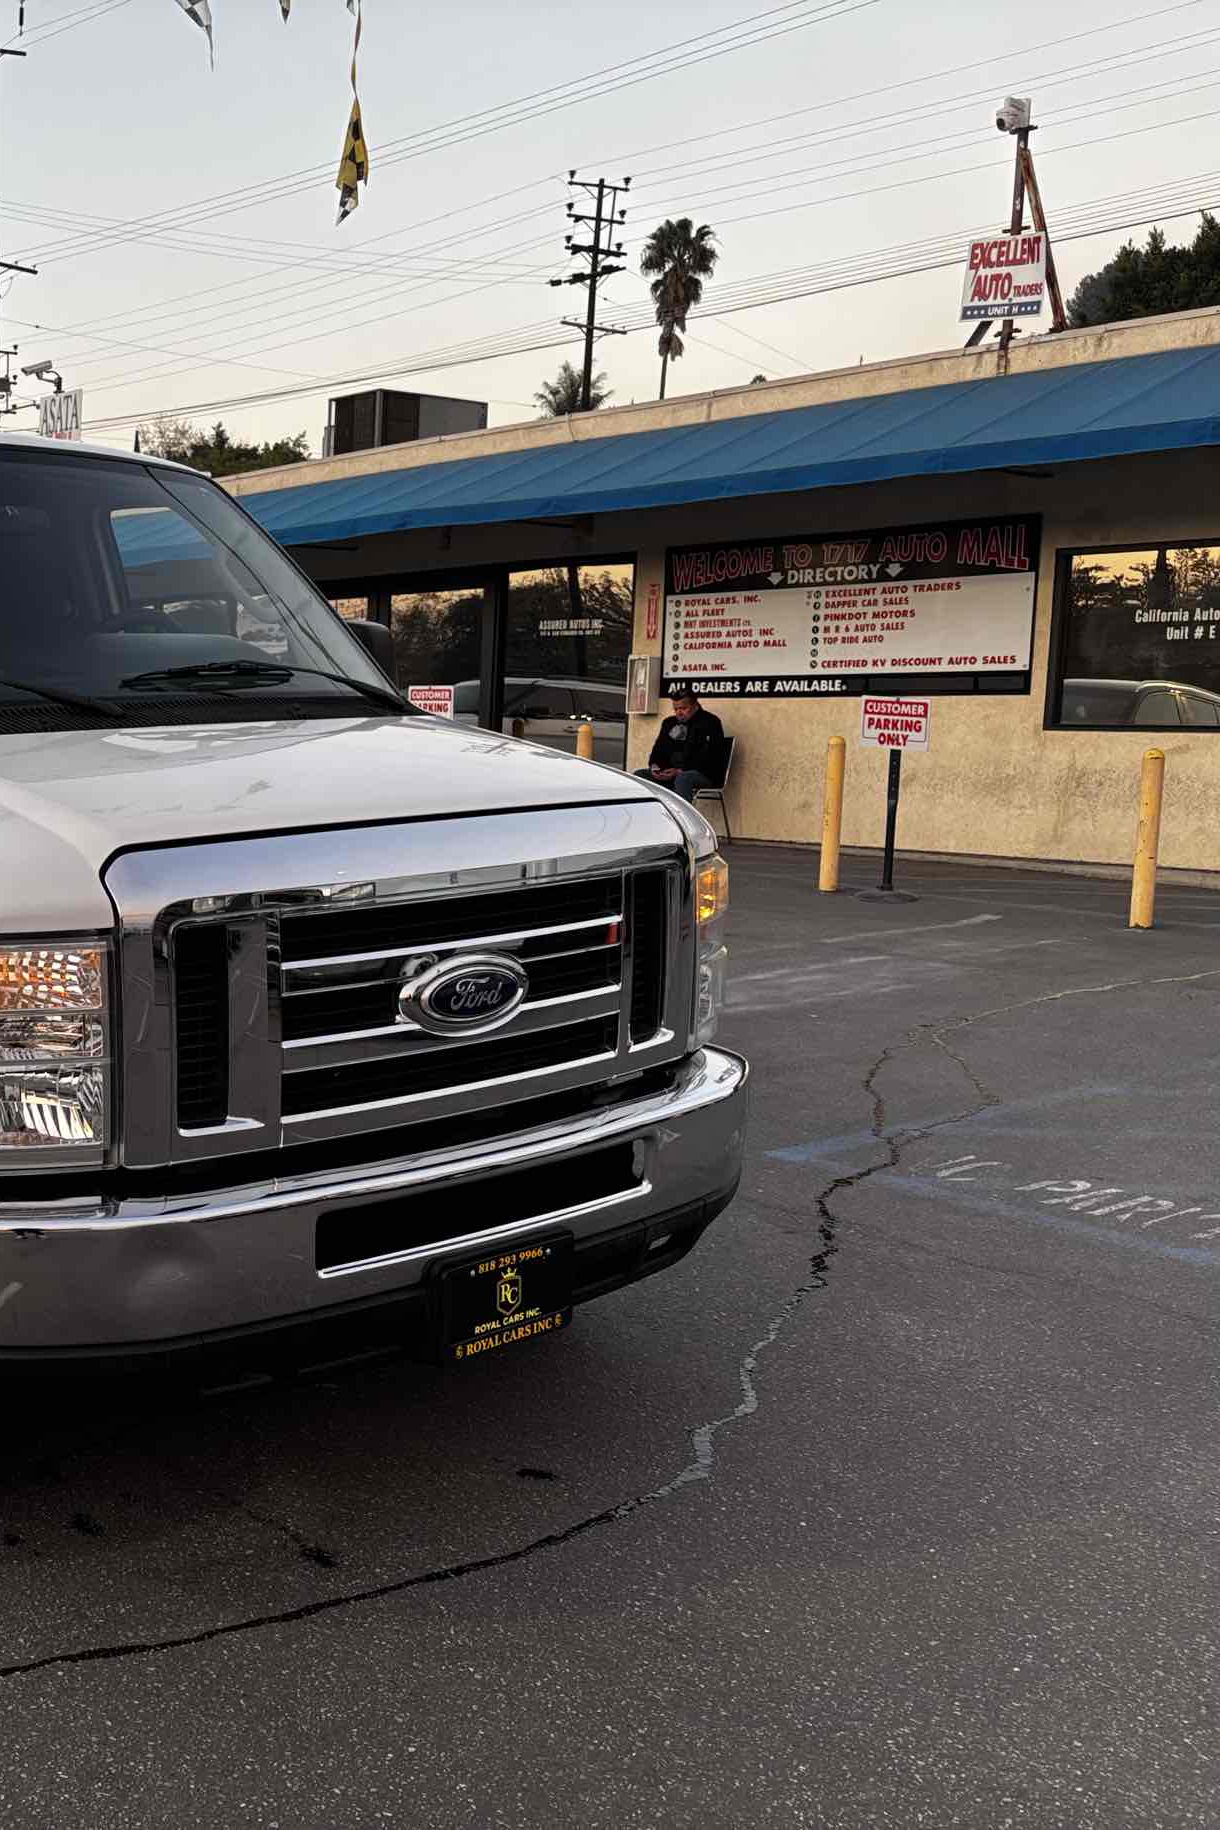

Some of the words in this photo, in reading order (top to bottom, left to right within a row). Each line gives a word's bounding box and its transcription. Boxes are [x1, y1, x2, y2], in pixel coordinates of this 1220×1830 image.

[970, 236, 1041, 270] EXCELLENT
[971, 272, 1012, 302] AUTO
[1013, 283, 1043, 297] TRADERS
[988, 306, 1008, 316] UNIT
[40, 393, 79, 437] ASATA
[672, 546, 774, 592] WELCOME
[783, 543, 812, 569] TO
[822, 540, 871, 565] 1717
[880, 531, 947, 563] AUTO
[956, 526, 1030, 571] MALL
[787, 564, 882, 585] DIRECTORY
[825, 588, 877, 599] EXCELLENT
[880, 585, 908, 595] AUTO
[913, 582, 962, 593] TRADERS
[684, 599, 710, 607] ROYAL
[824, 600, 858, 609] DAPPER
[861, 599, 878, 607] CAR
[883, 597, 909, 606] SALES
[685, 609, 700, 618] ALL
[702, 608, 725, 617] FLEET
[823, 612, 868, 622] PINKDOT
[872, 609, 916, 619] MOTORS
[1135, 608, 1189, 624] California
[1194, 607, 1220, 621] Auto
[684, 631, 722, 639] ASSURED
[725, 629, 753, 638] AUTOS
[854, 624, 877, 633] AUTO
[881, 622, 905, 631] SALES
[1167, 626, 1189, 641] Unit
[1194, 626, 1205, 639] #
[1209, 625, 1217, 639] E
[684, 642, 733, 650] CALIFORNIA
[736, 640, 760, 649] AUTO
[764, 639, 787, 648] MALL
[823, 637, 839, 646] TOP
[841, 636, 860, 645] RIDE
[862, 635, 885, 644] AUTO
[682, 664, 708, 672] ASATA
[821, 660, 868, 669] CERTIFIED
[891, 657, 942, 667] DISCOUNT
[947, 656, 978, 666] AUTO
[982, 655, 1017, 665] SALES
[692, 681, 740, 693] DEALERS
[745, 681, 769, 693] ARE
[774, 680, 847, 692] AVAILABLE.
[411, 691, 450, 700] CUSTOMER
[866, 702, 925, 716] CUSTOMER
[867, 717, 922, 733] PARKING
[877, 733, 909, 747] ONLY
[450, 977, 503, 1012] Ford
[478, 1260, 497, 1274] 818
[499, 1254, 517, 1268] 293
[474, 1320, 502, 1335] ROYAL
[503, 1312, 525, 1326] CARS
[466, 1336, 502, 1357] ROYAL
[503, 1324, 532, 1343] CARS
[533, 1317, 553, 1334] INC
